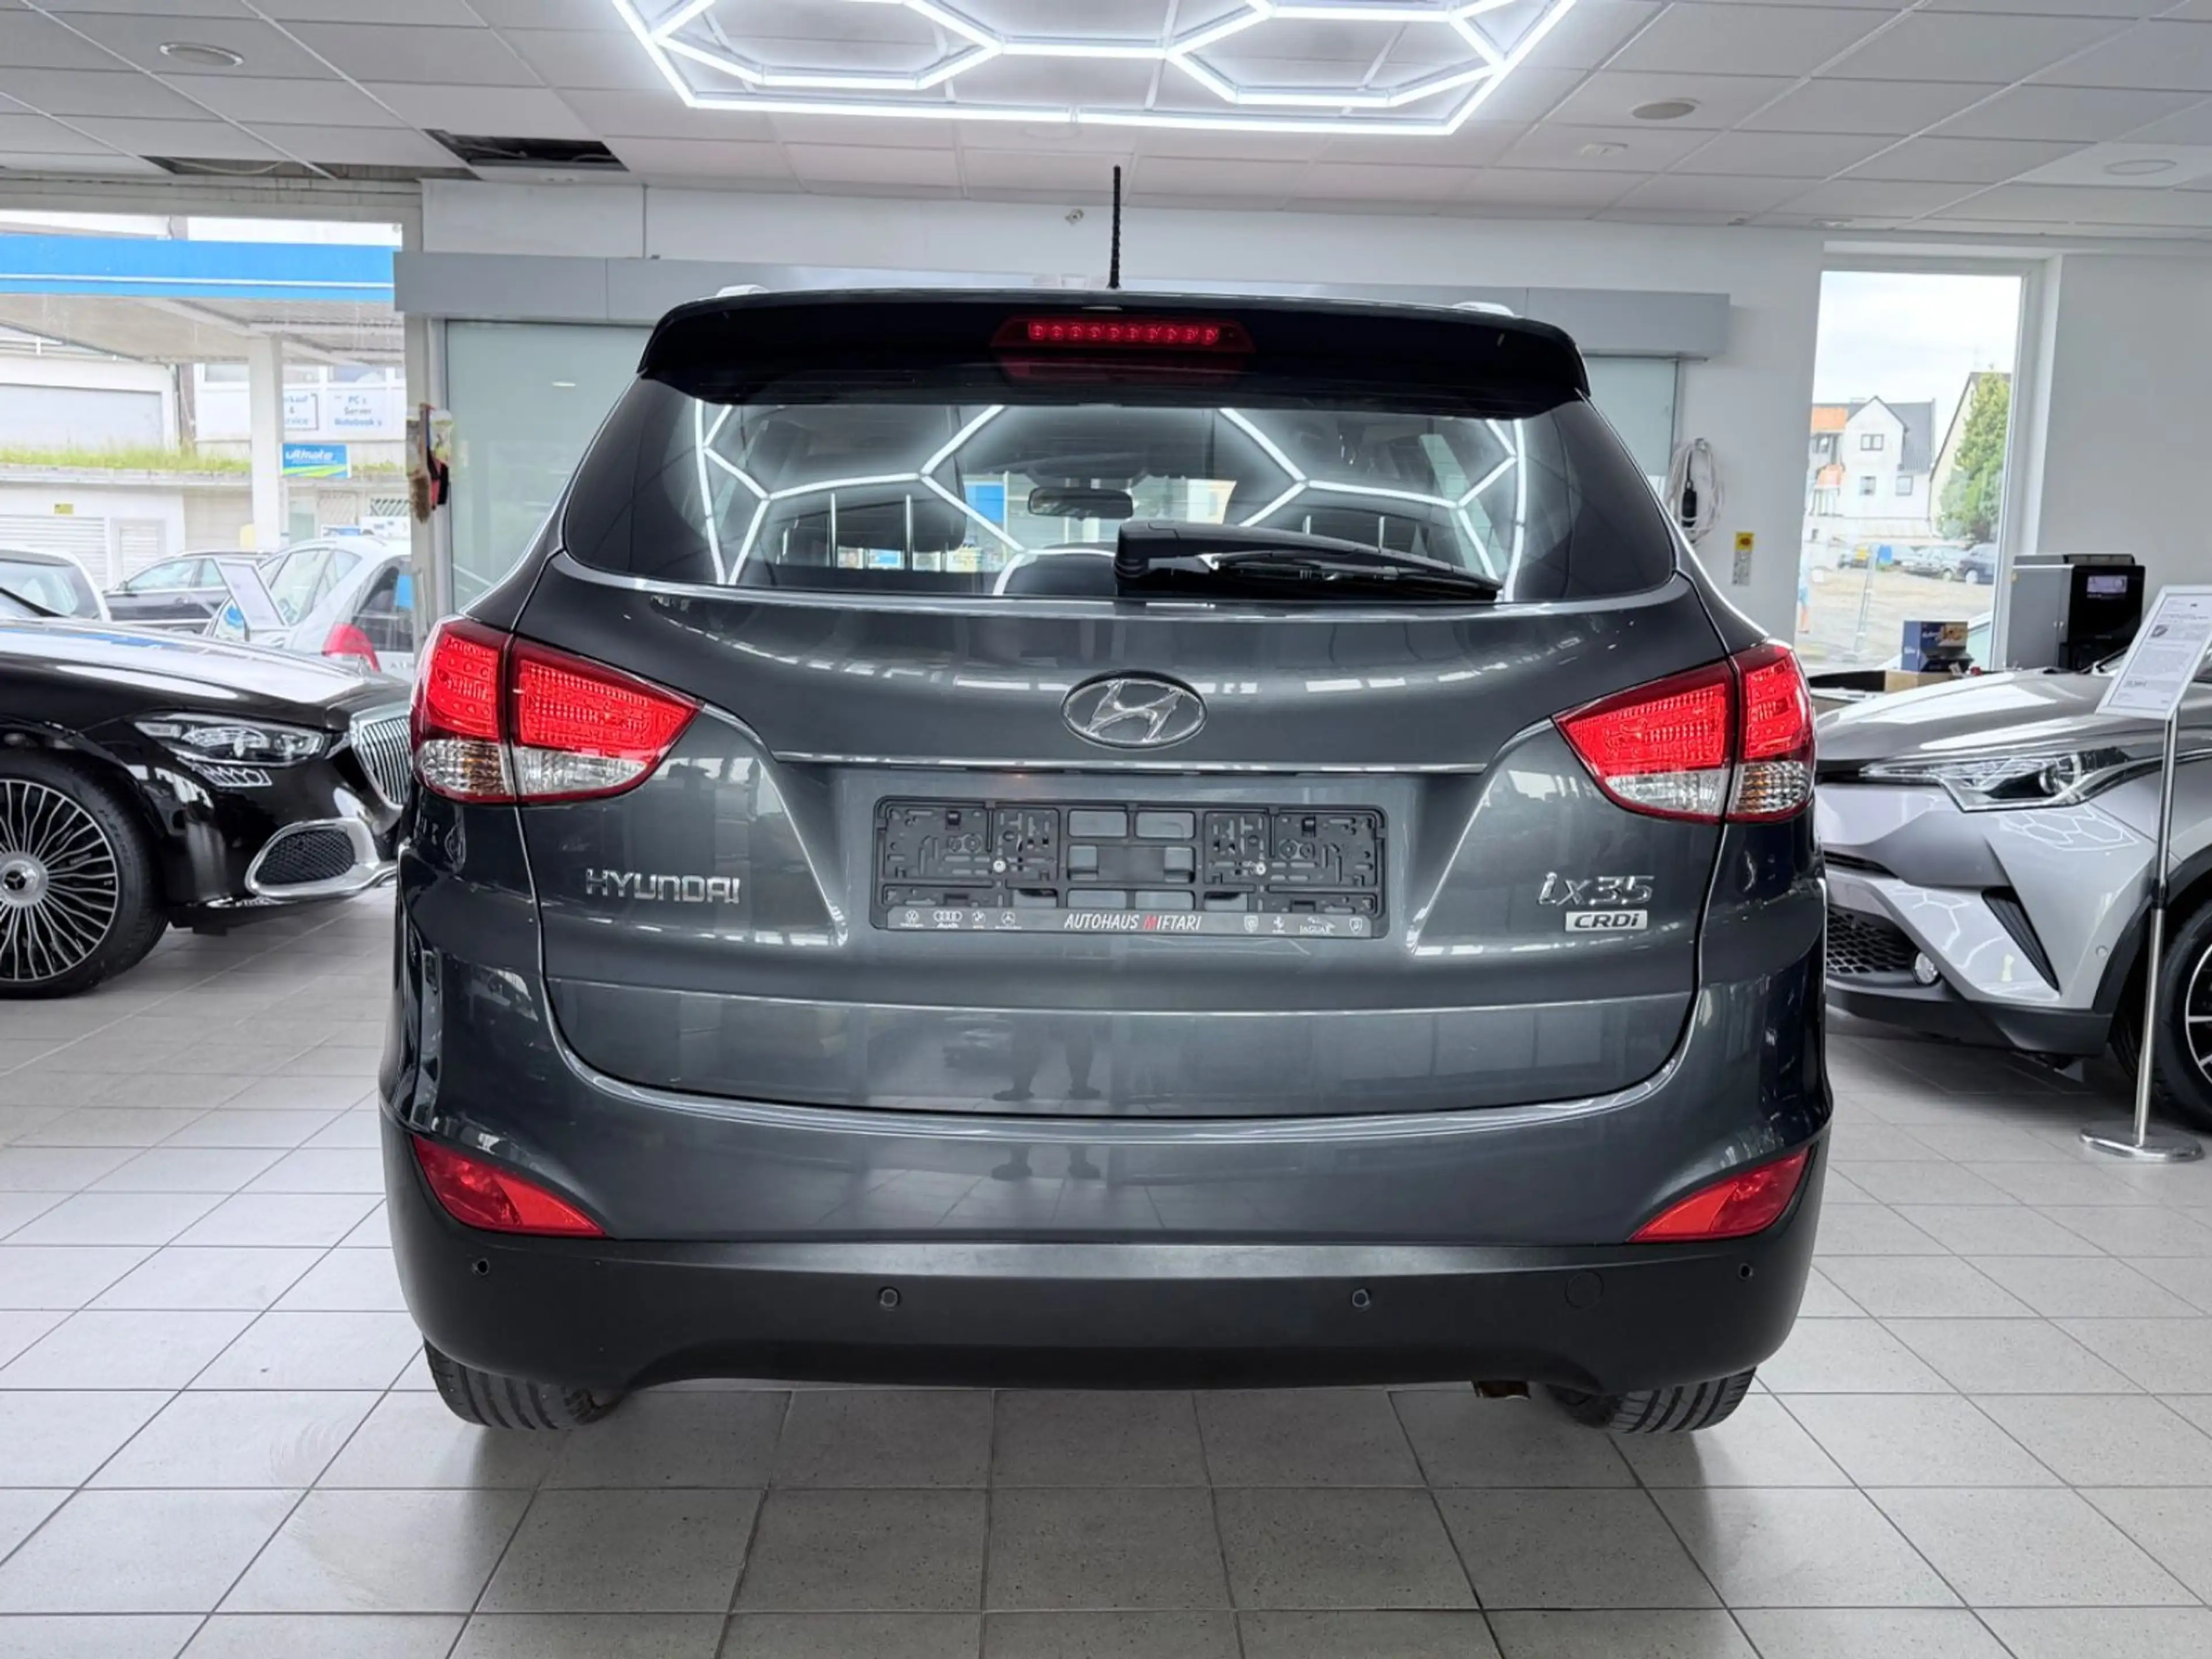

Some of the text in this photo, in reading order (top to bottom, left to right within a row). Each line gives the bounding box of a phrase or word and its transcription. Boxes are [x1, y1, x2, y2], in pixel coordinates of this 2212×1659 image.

[285, 449, 334, 460] ultimate
[585, 868, 741, 904] HYUNDAI
[1536, 871, 1656, 907] ix35
[1064, 914, 1202, 931] AUTOHAUS MIFTARI
[1574, 912, 1639, 929] CRDi
